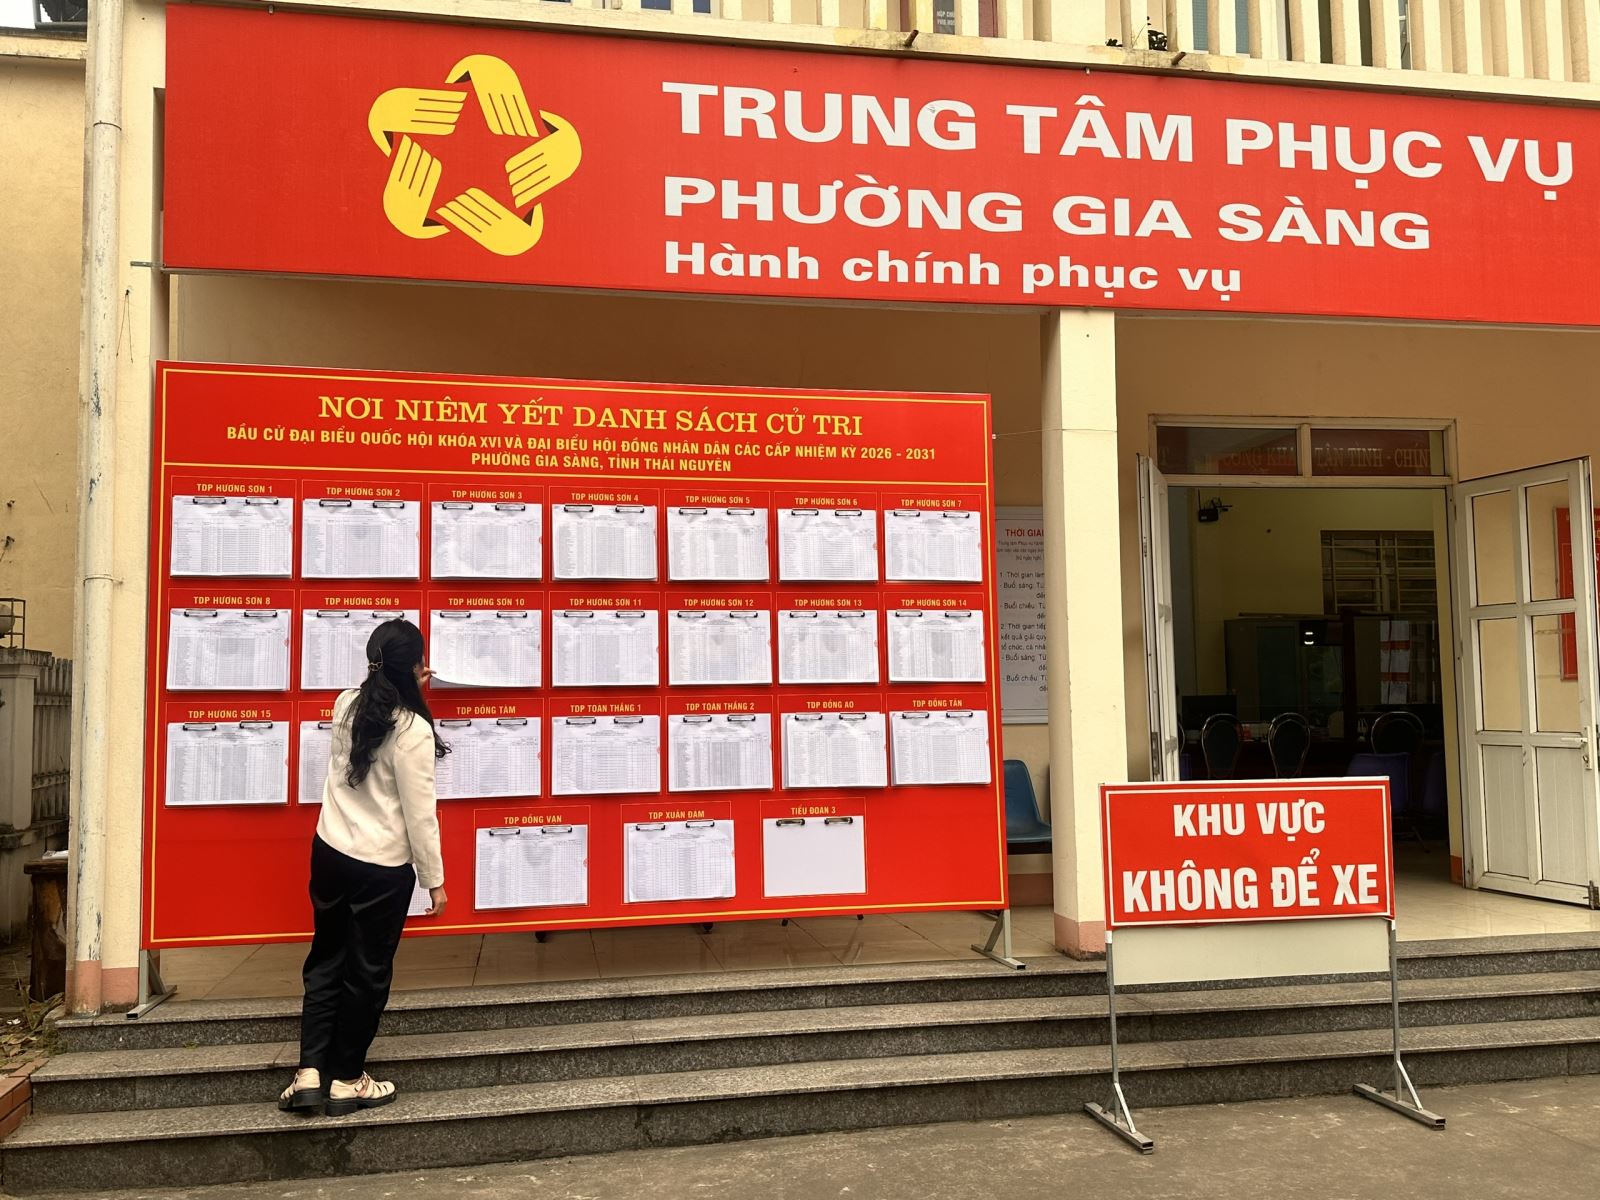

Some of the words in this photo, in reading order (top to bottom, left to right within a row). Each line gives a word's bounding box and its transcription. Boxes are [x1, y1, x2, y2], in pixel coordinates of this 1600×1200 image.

[662, 81, 976, 150] TRUNG
[1006, 95, 1193, 162] TÂM
[1226, 118, 1442, 189] PHỤC
[1467, 136, 1573, 200] VỤ
[665, 175, 1022, 232] PHƯỜNG
[1052, 196, 1192, 239] GIA
[1218, 196, 1430, 250] SÀNG
[666, 241, 819, 280] Hành
[842, 250, 1000, 285] chính
[1023, 256, 1158, 298] phục
[1177, 268, 1240, 301] vụ
[318, 396, 384, 419] NƠI
[395, 396, 487, 423] NIÊM
[497, 397, 563, 426] YẾT
[573, 406, 667, 430] DANH
[676, 406, 758, 433] SÁCH
[766, 407, 806, 435] CỬ
[813, 415, 863, 436] TRI
[226, 423, 258, 441] BẦU
[263, 425, 285, 441] CỬ
[289, 429, 315, 444] ĐẠI
[321, 428, 355, 443] BIỂU
[361, 429, 401, 445] QUỐC
[407, 431, 432, 448] HỘI
[438, 433, 477, 447] KHÓA
[480, 436, 501, 448] XVI
[504, 435, 523, 449] VÀ
[527, 437, 551, 452] ĐẠI
[556, 434, 588, 451] BIỂU
[593, 437, 619, 453] HỘI
[621, 435, 659, 454] ĐỒNG
[663, 440, 699, 454] NHÂN
[704, 441, 730, 455] DÂN
[735, 442, 760, 456] CÁC
[765, 440, 791, 457] CẤP
[795, 444, 837, 460] NHIỆM
[841, 445, 856, 458] KỲ
[861, 447, 892, 459] 2026
[906, 448, 935, 460] 2031
[472, 452, 530, 466] PHƯỜNG
[535, 455, 558, 467] GIA
[563, 453, 603, 470] SÀNG,
[608, 454, 639, 469] TỈNH
[644, 458, 674, 470] THÁI
[679, 458, 731, 472] NGUYÊN
[327, 487, 342, 495] TDP
[452, 490, 467, 498] TDP
[265, 597, 270, 605] 8
[516, 598, 524, 606] 10
[686, 703, 700, 711] TDP
[832, 806, 836, 814] 3
[1173, 803, 1245, 837] KHU
[1256, 799, 1325, 841] VỰC
[1123, 860, 1259, 913] KHÔNG
[1270, 847, 1321, 907] ĐỂ
[1332, 864, 1380, 905] XE
